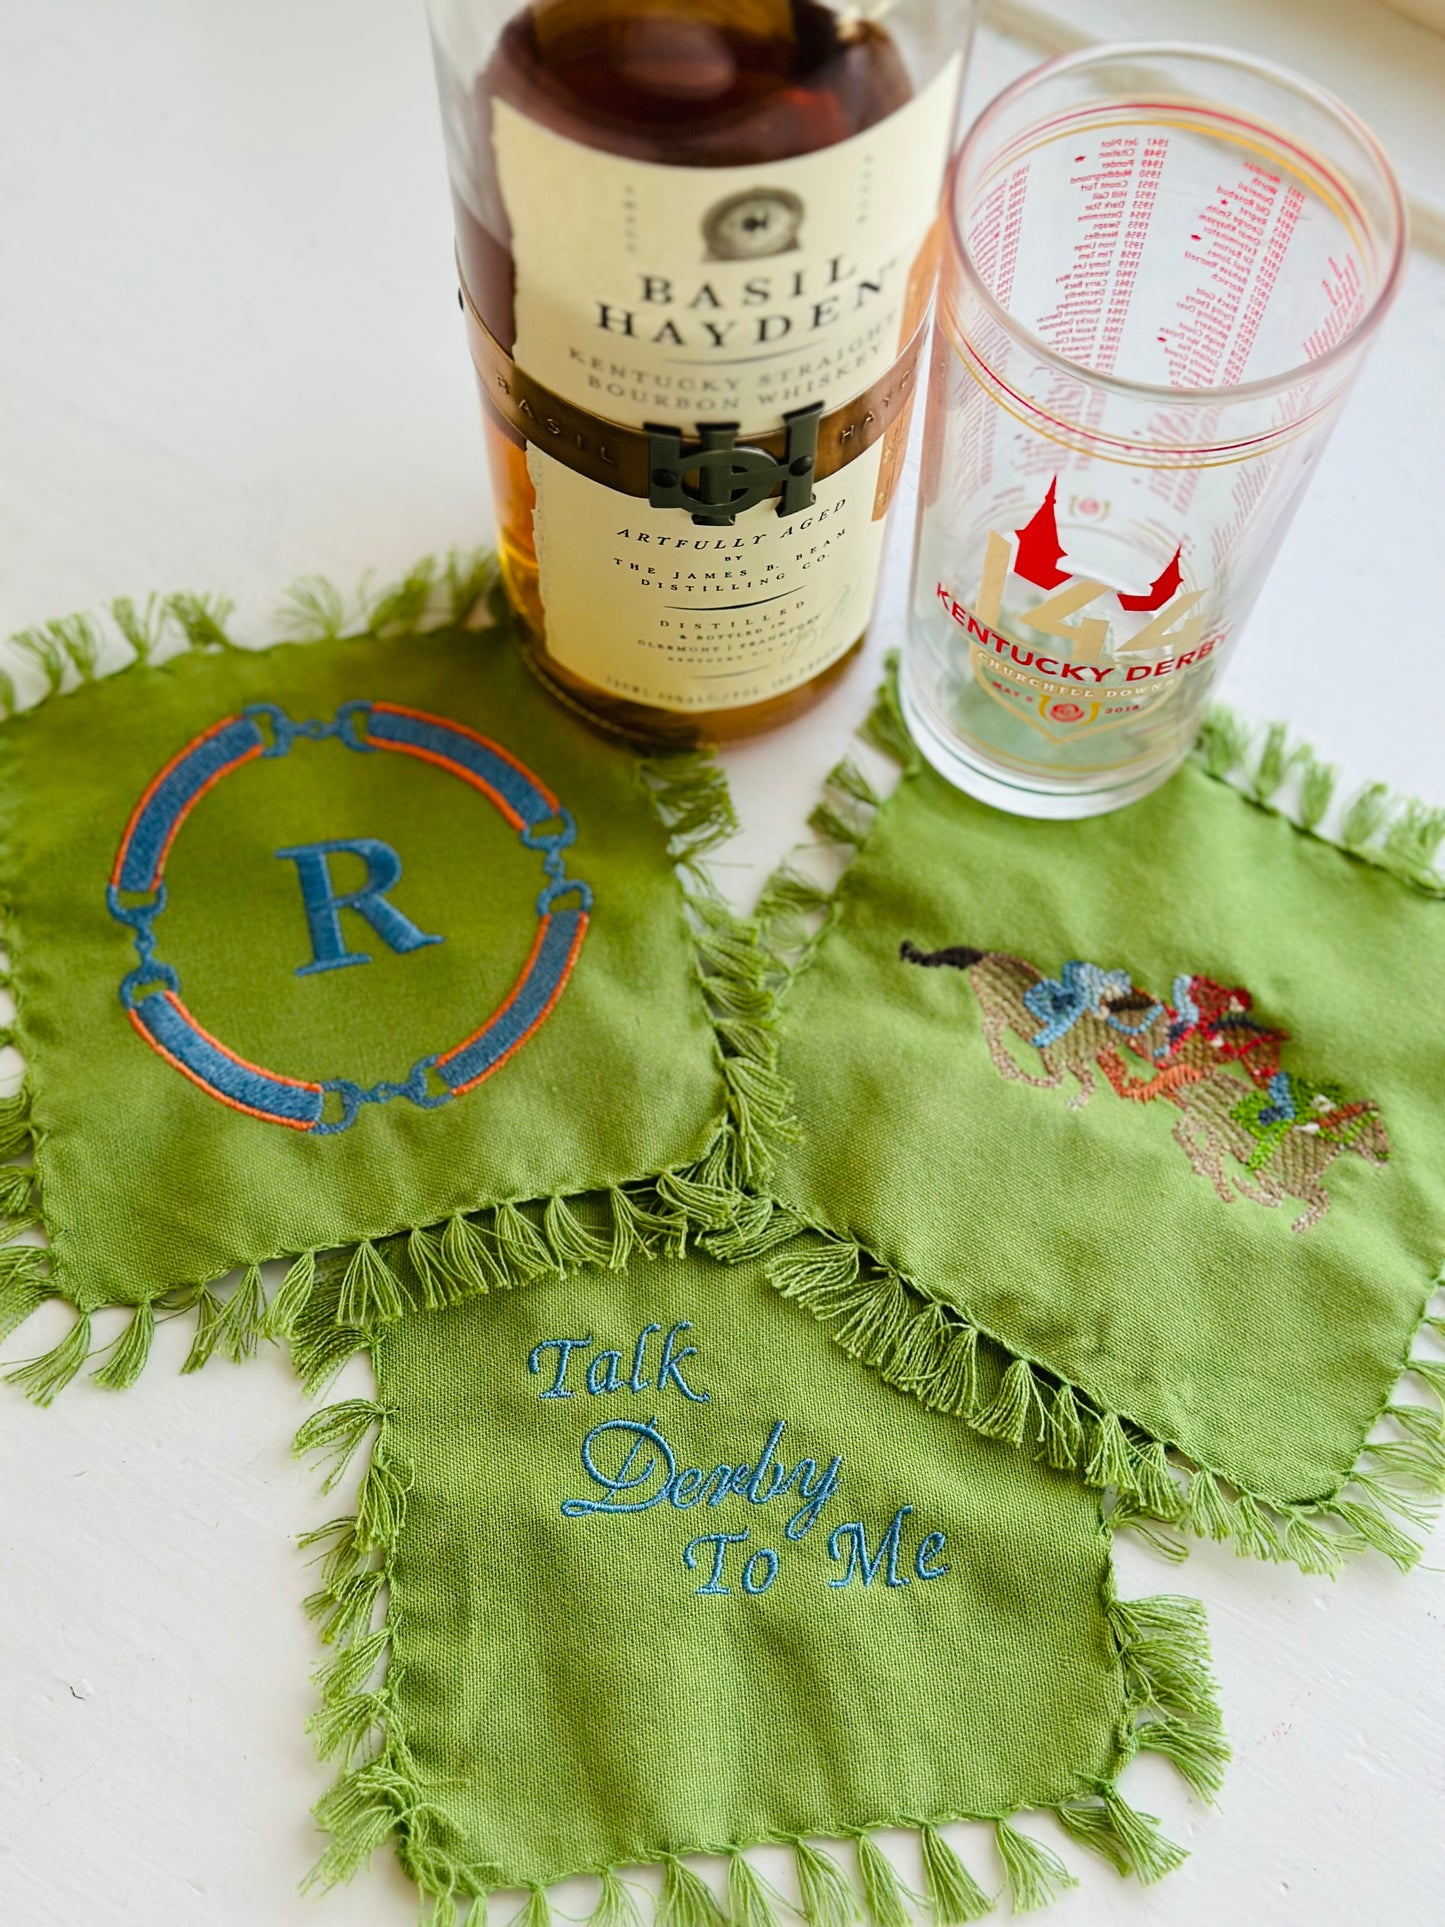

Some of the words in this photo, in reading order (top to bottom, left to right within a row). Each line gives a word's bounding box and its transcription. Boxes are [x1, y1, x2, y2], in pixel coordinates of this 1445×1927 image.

[595, 258, 897, 347] HAYDEN
[640, 254, 857, 309] BASIL
[568, 347, 742, 393] KENTUCKY
[757, 309, 897, 387] STRAIGHT
[587, 375, 741, 411] BOURBON
[756, 337, 887, 408] WHISKEY
[496, 371, 614, 464] BASIL
[613, 557, 656, 575] THE
[673, 568, 748, 580] JAMES
[766, 563, 780, 572] B.
[796, 528, 847, 561] BEAM
[617, 528, 767, 550] ARTFULLY
[780, 498, 846, 538] AGED
[640, 572, 786, 592] DISTILLING
[802, 553, 831, 570] CO.
[724, 554, 743, 562] BY
[660, 601, 805, 630] DISTILLED
[696, 627, 763, 641] BOTTLED
[936, 580, 1114, 683] KENTUCKY
[1125, 632, 1232, 682] DERBY
[978, 652, 1095, 698] CHURCHILL
[1105, 678, 1176, 698] DOWNS
[992, 680, 1021, 698] MAY
[1104, 704, 1141, 715] 2018
[274, 838, 445, 977] R
[528, 1320, 710, 1403] Talk
[561, 1416, 842, 1540] Derby
[683, 1526, 780, 1595] To
[828, 1504, 949, 1590] Me
